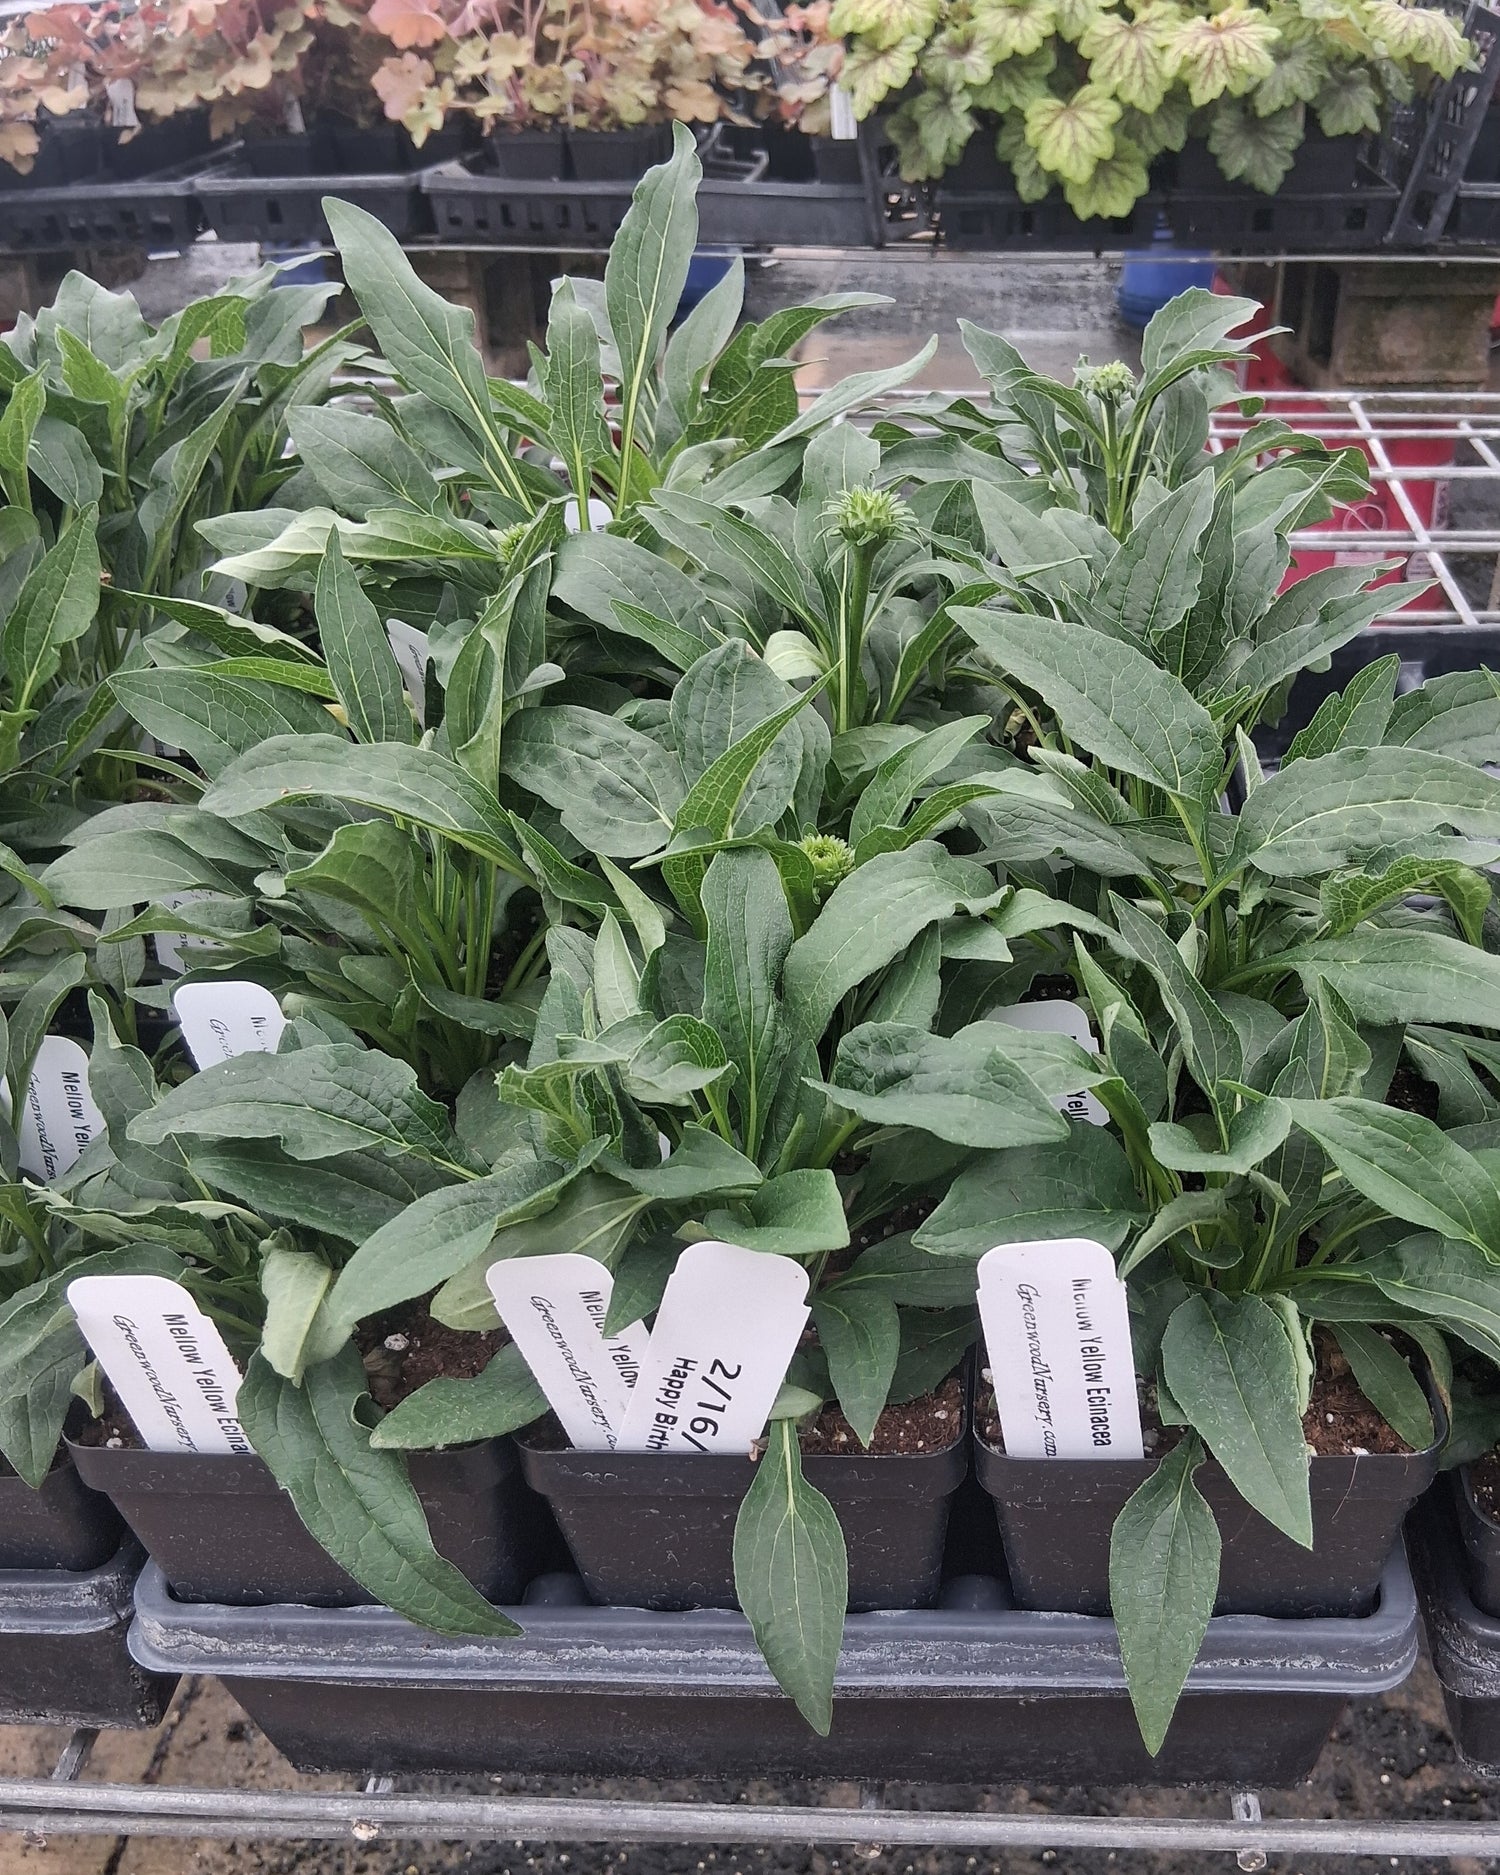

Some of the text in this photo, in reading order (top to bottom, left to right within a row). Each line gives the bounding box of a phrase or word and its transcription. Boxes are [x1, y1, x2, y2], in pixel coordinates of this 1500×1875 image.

[61, 1071, 85, 1120] Mellow
[162, 1314, 252, 1455] Mellow Yellow Ecina
[1016, 1282, 1057, 1458] GreenwoodNursery.com
[1079, 1336, 1107, 1384] Yellow
[645, 1357, 699, 1450] Happy Birth
[1086, 1387, 1112, 1447] Ecinacea
